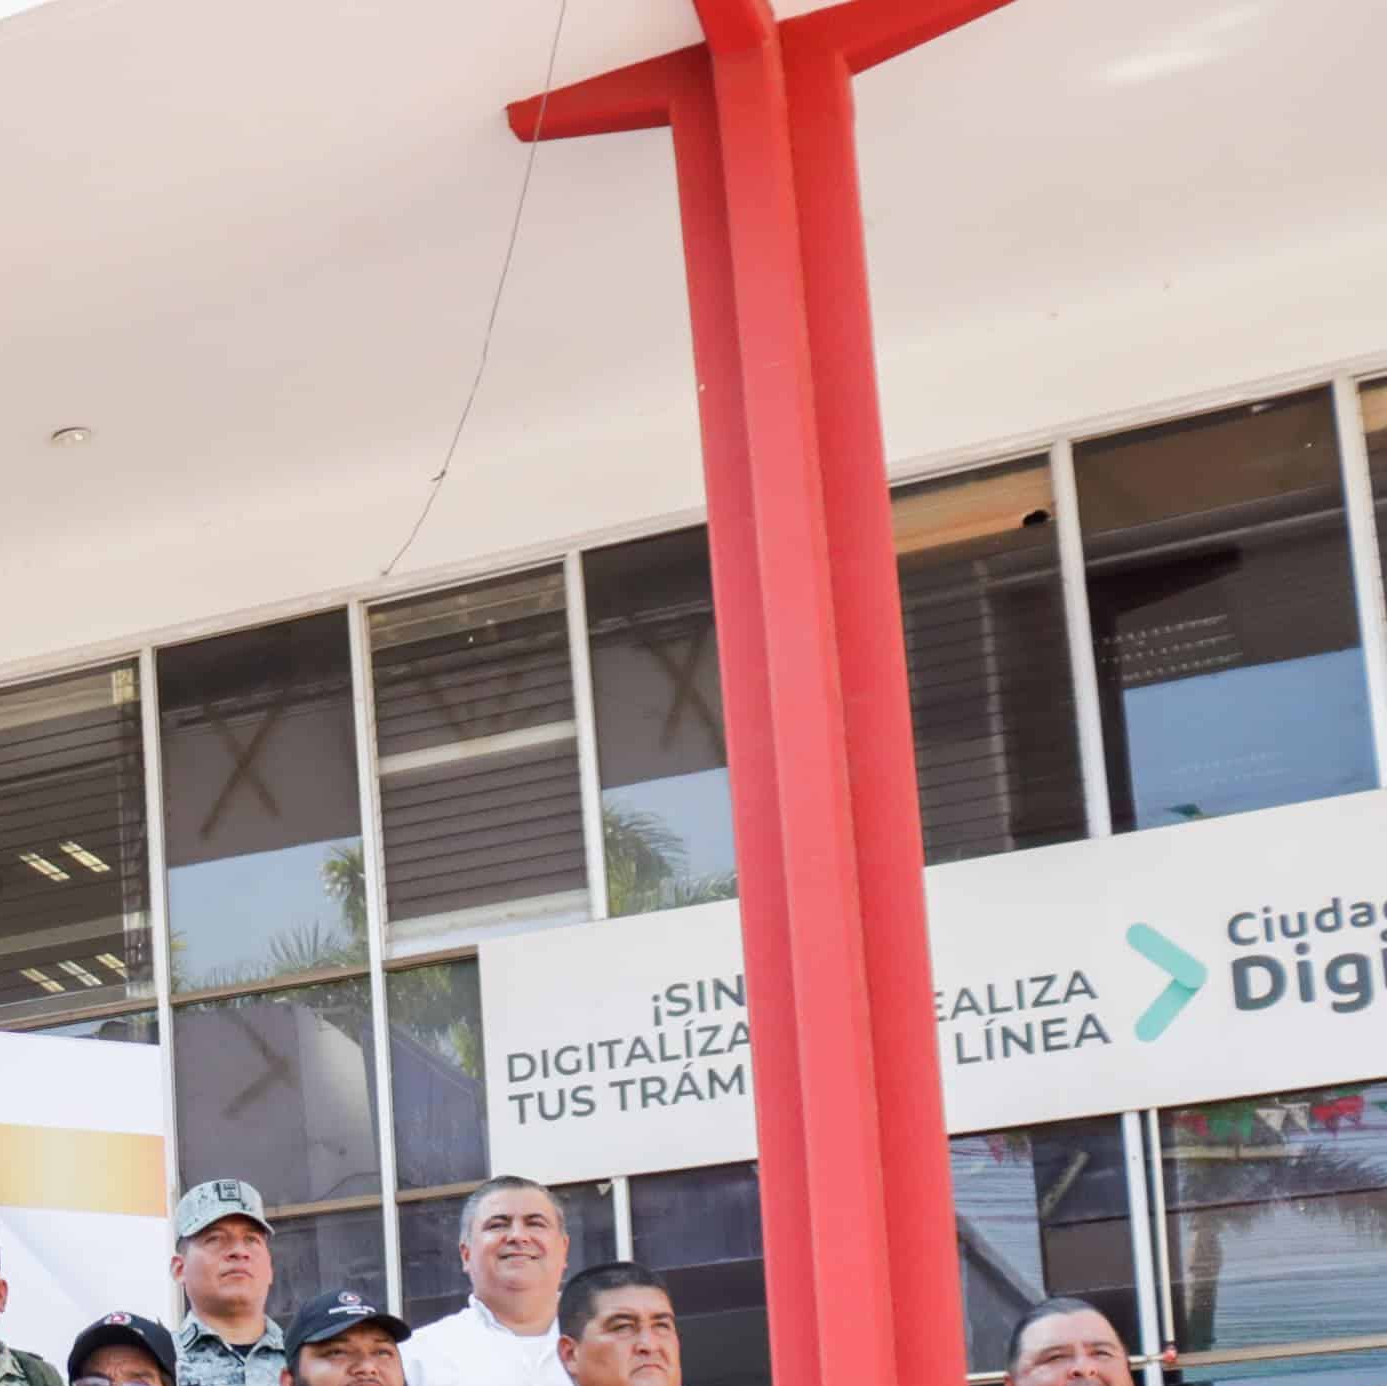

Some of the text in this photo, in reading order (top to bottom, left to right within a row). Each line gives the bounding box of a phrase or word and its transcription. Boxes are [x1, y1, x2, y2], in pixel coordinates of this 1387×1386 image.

[1227, 897, 1387, 946] Ciuda
[1231, 928, 1387, 1014] Dig
[507, 1020, 752, 1083] DIGITALÍZA
[508, 1013, 1112, 1125] TUS TRÁM LÍNEA
